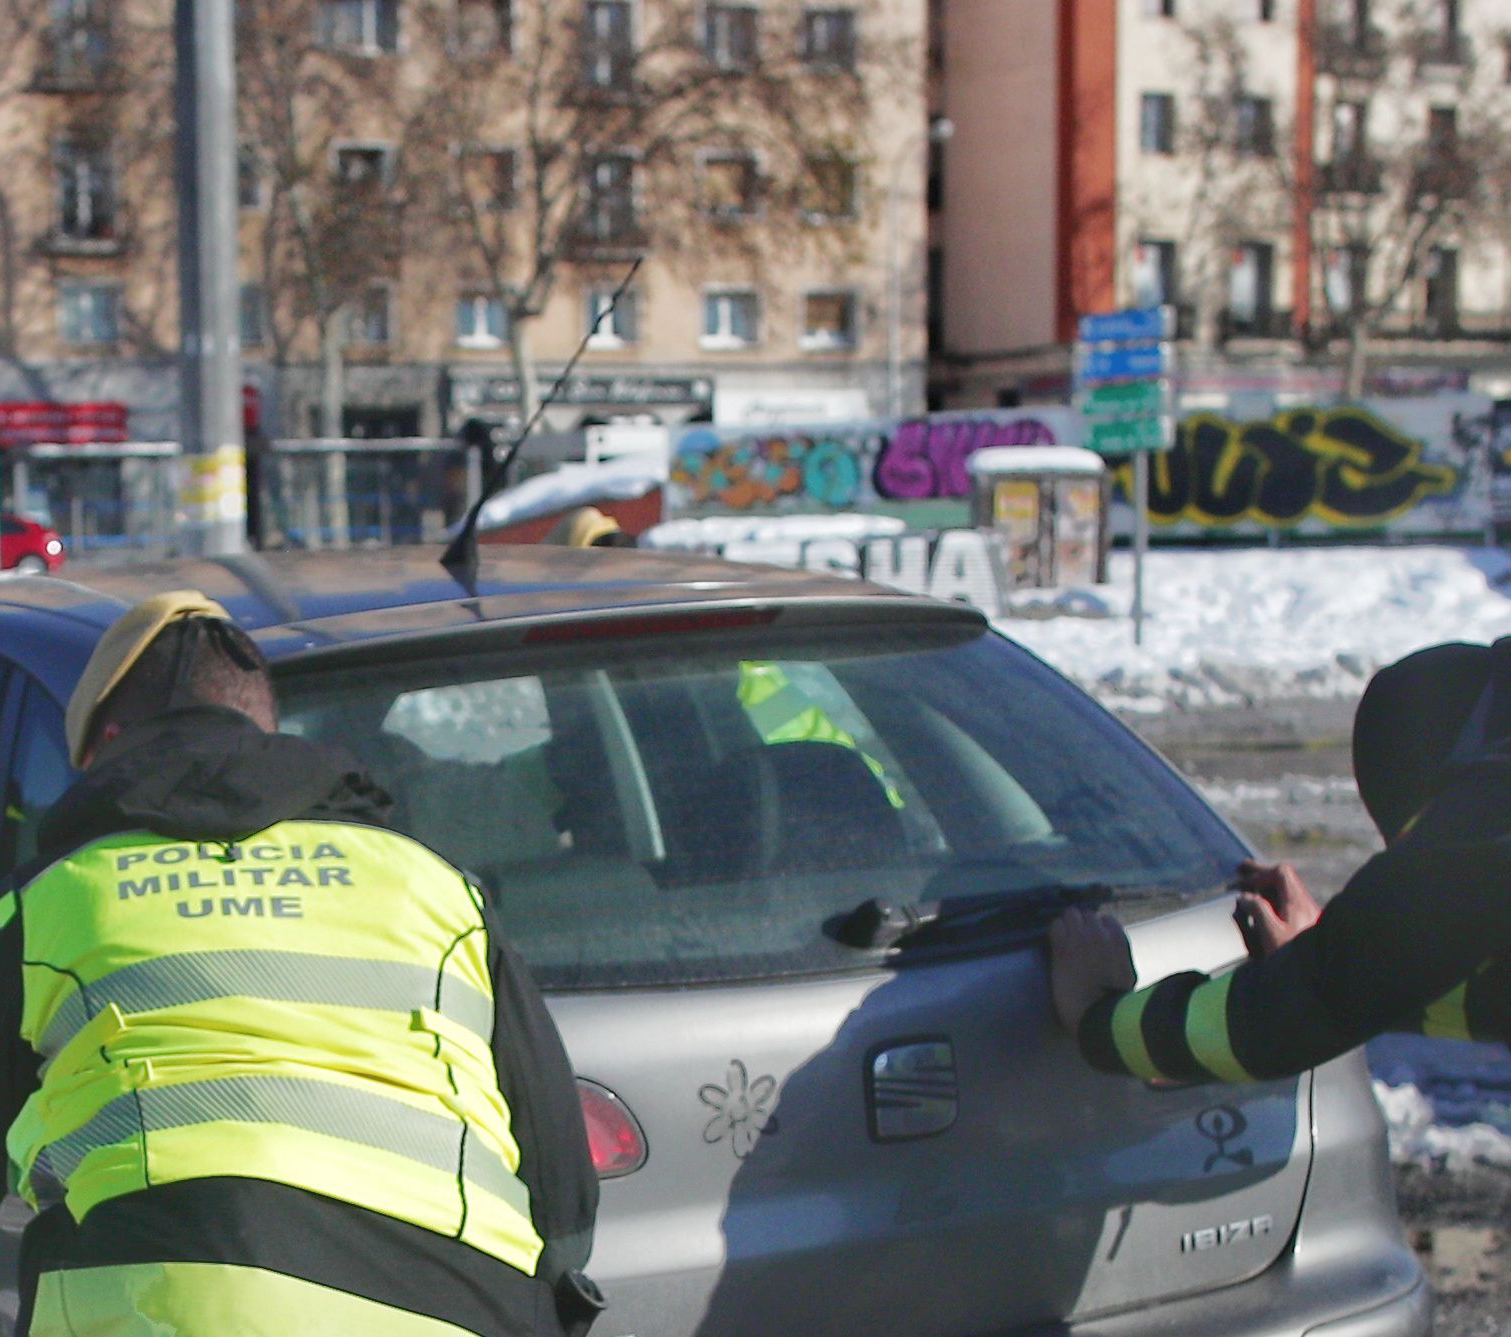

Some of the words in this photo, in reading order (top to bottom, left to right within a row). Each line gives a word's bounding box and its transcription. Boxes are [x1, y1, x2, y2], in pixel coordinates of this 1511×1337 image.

[117, 866, 354, 900] MILITAR
[176, 896, 304, 919] UME
[1180, 1214, 1274, 1254] IBIZA
